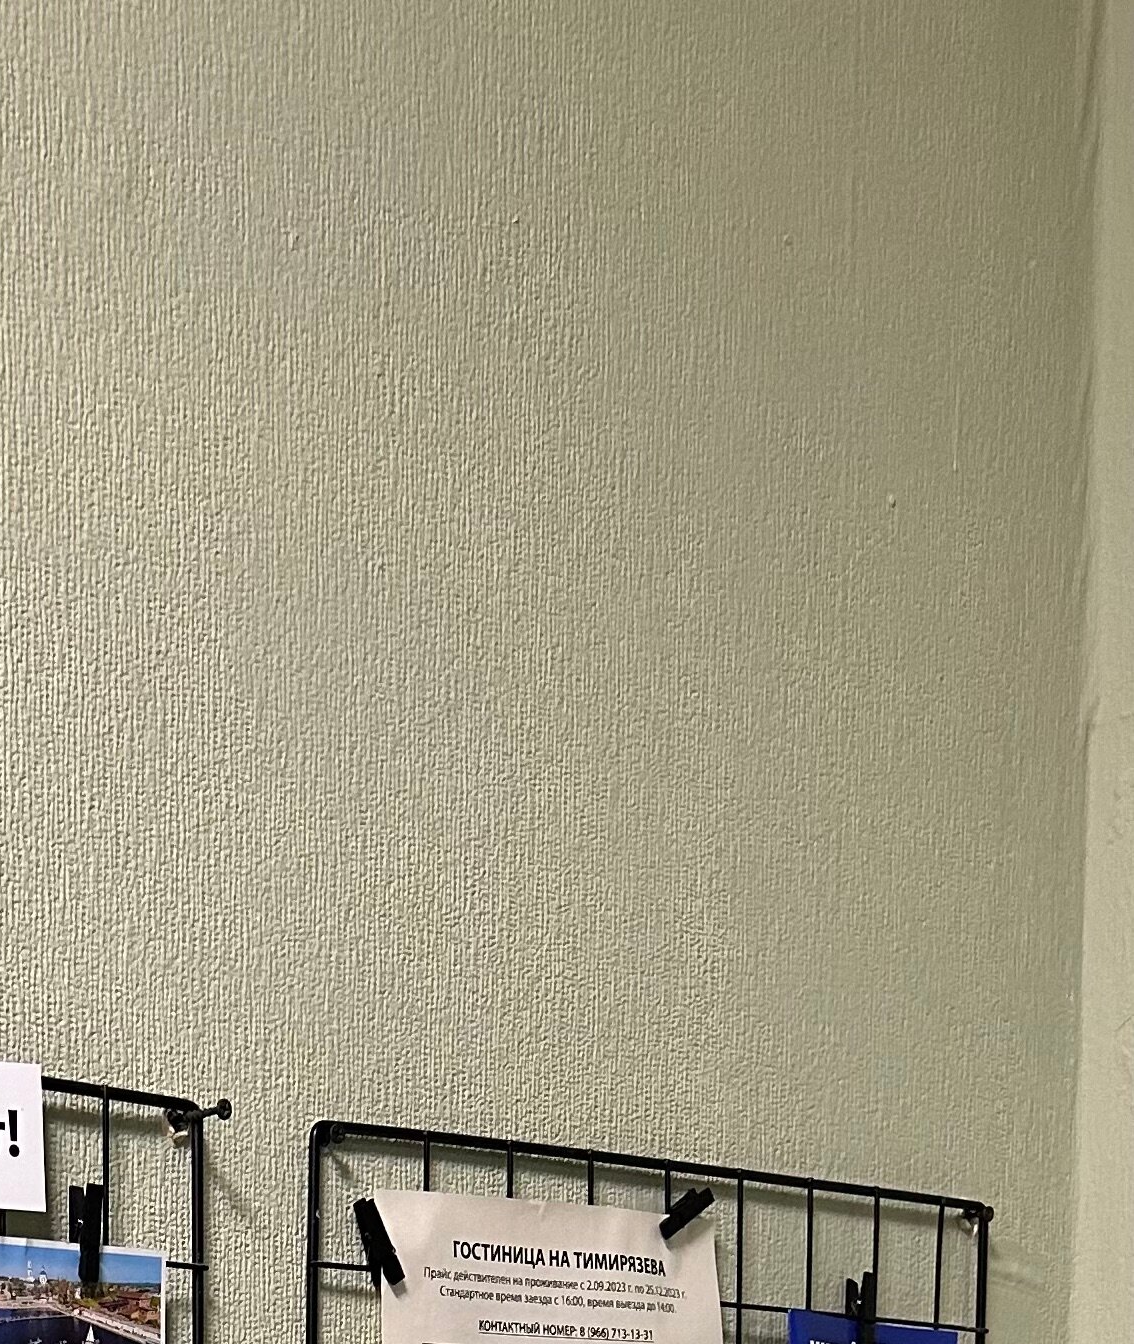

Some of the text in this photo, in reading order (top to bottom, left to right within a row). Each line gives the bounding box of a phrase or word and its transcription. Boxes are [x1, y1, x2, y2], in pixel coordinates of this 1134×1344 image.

[453, 1240, 666, 1277] ГОСТИНИЦА НА ТИМИРЯЗЕВА
[587, 1280, 626, 1292] 2.09.2023
[561, 1296, 585, 1308] 16:00,
[479, 1320, 653, 1340] КОНТАКТНЫЙ НОМЕР: 8 (966) 713-13-31
